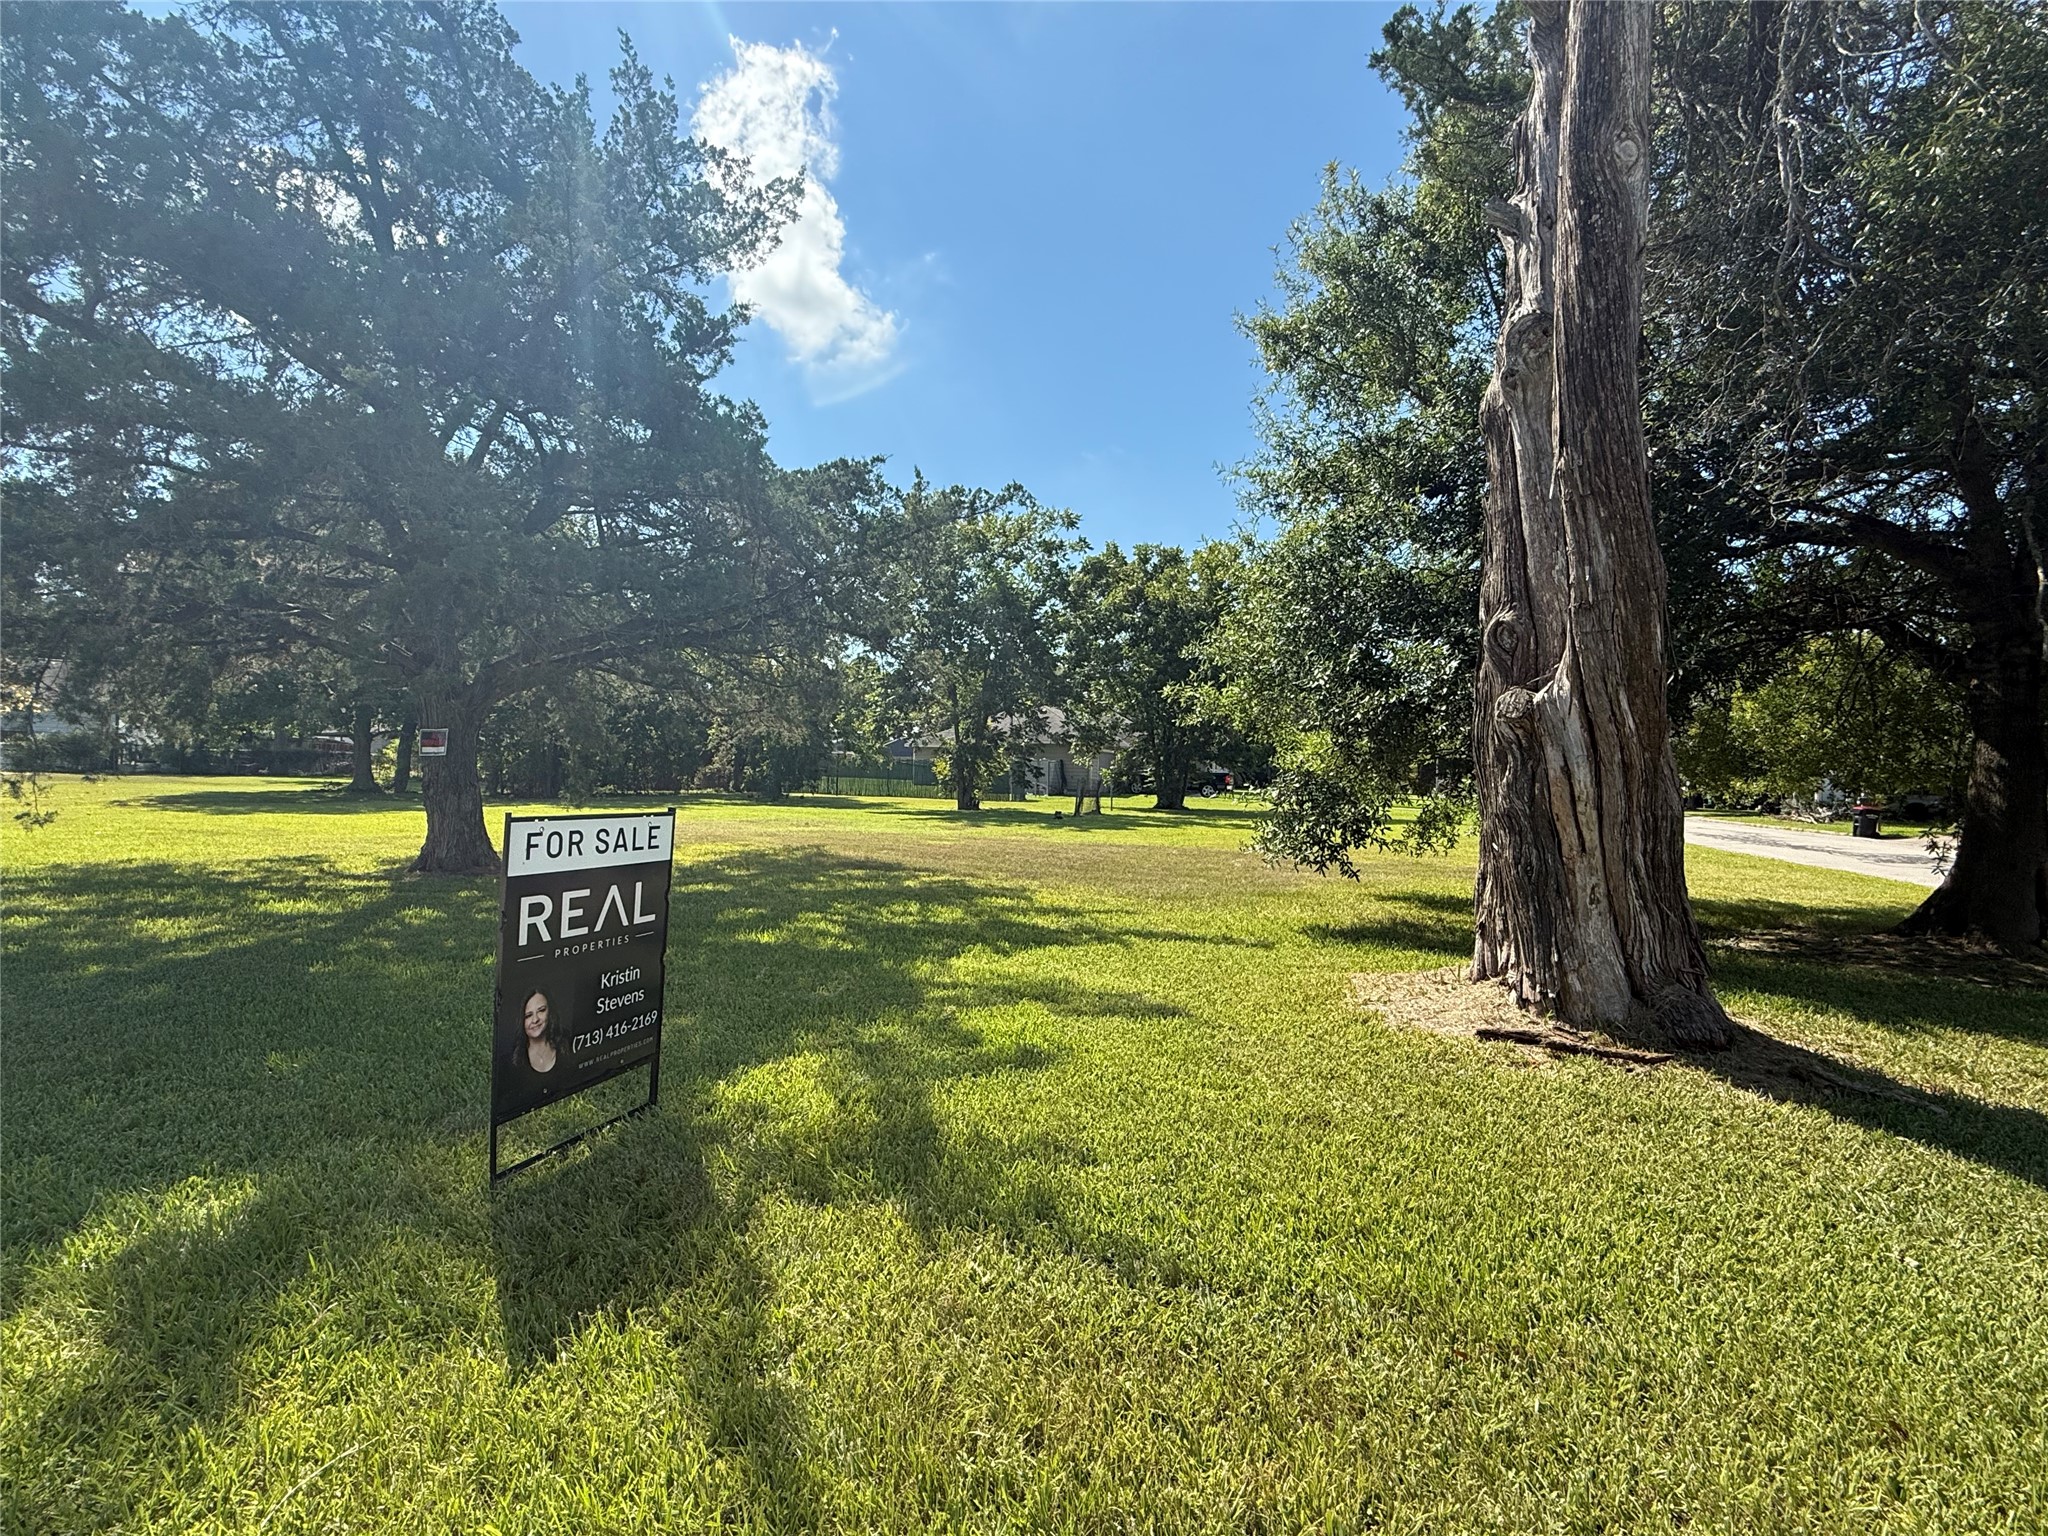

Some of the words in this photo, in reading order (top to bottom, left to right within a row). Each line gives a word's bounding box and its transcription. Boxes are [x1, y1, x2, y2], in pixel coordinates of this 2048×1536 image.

[525, 830, 584, 861] FOR
[595, 825, 661, 855] SALE
[518, 881, 656, 946] REAL
[554, 935, 630, 958] PROPERTIES
[601, 966, 641, 989] Kristin
[596, 988, 645, 1014] Stevens
[572, 1028, 603, 1053] (713)
[605, 1010, 658, 1039] 416-2169
